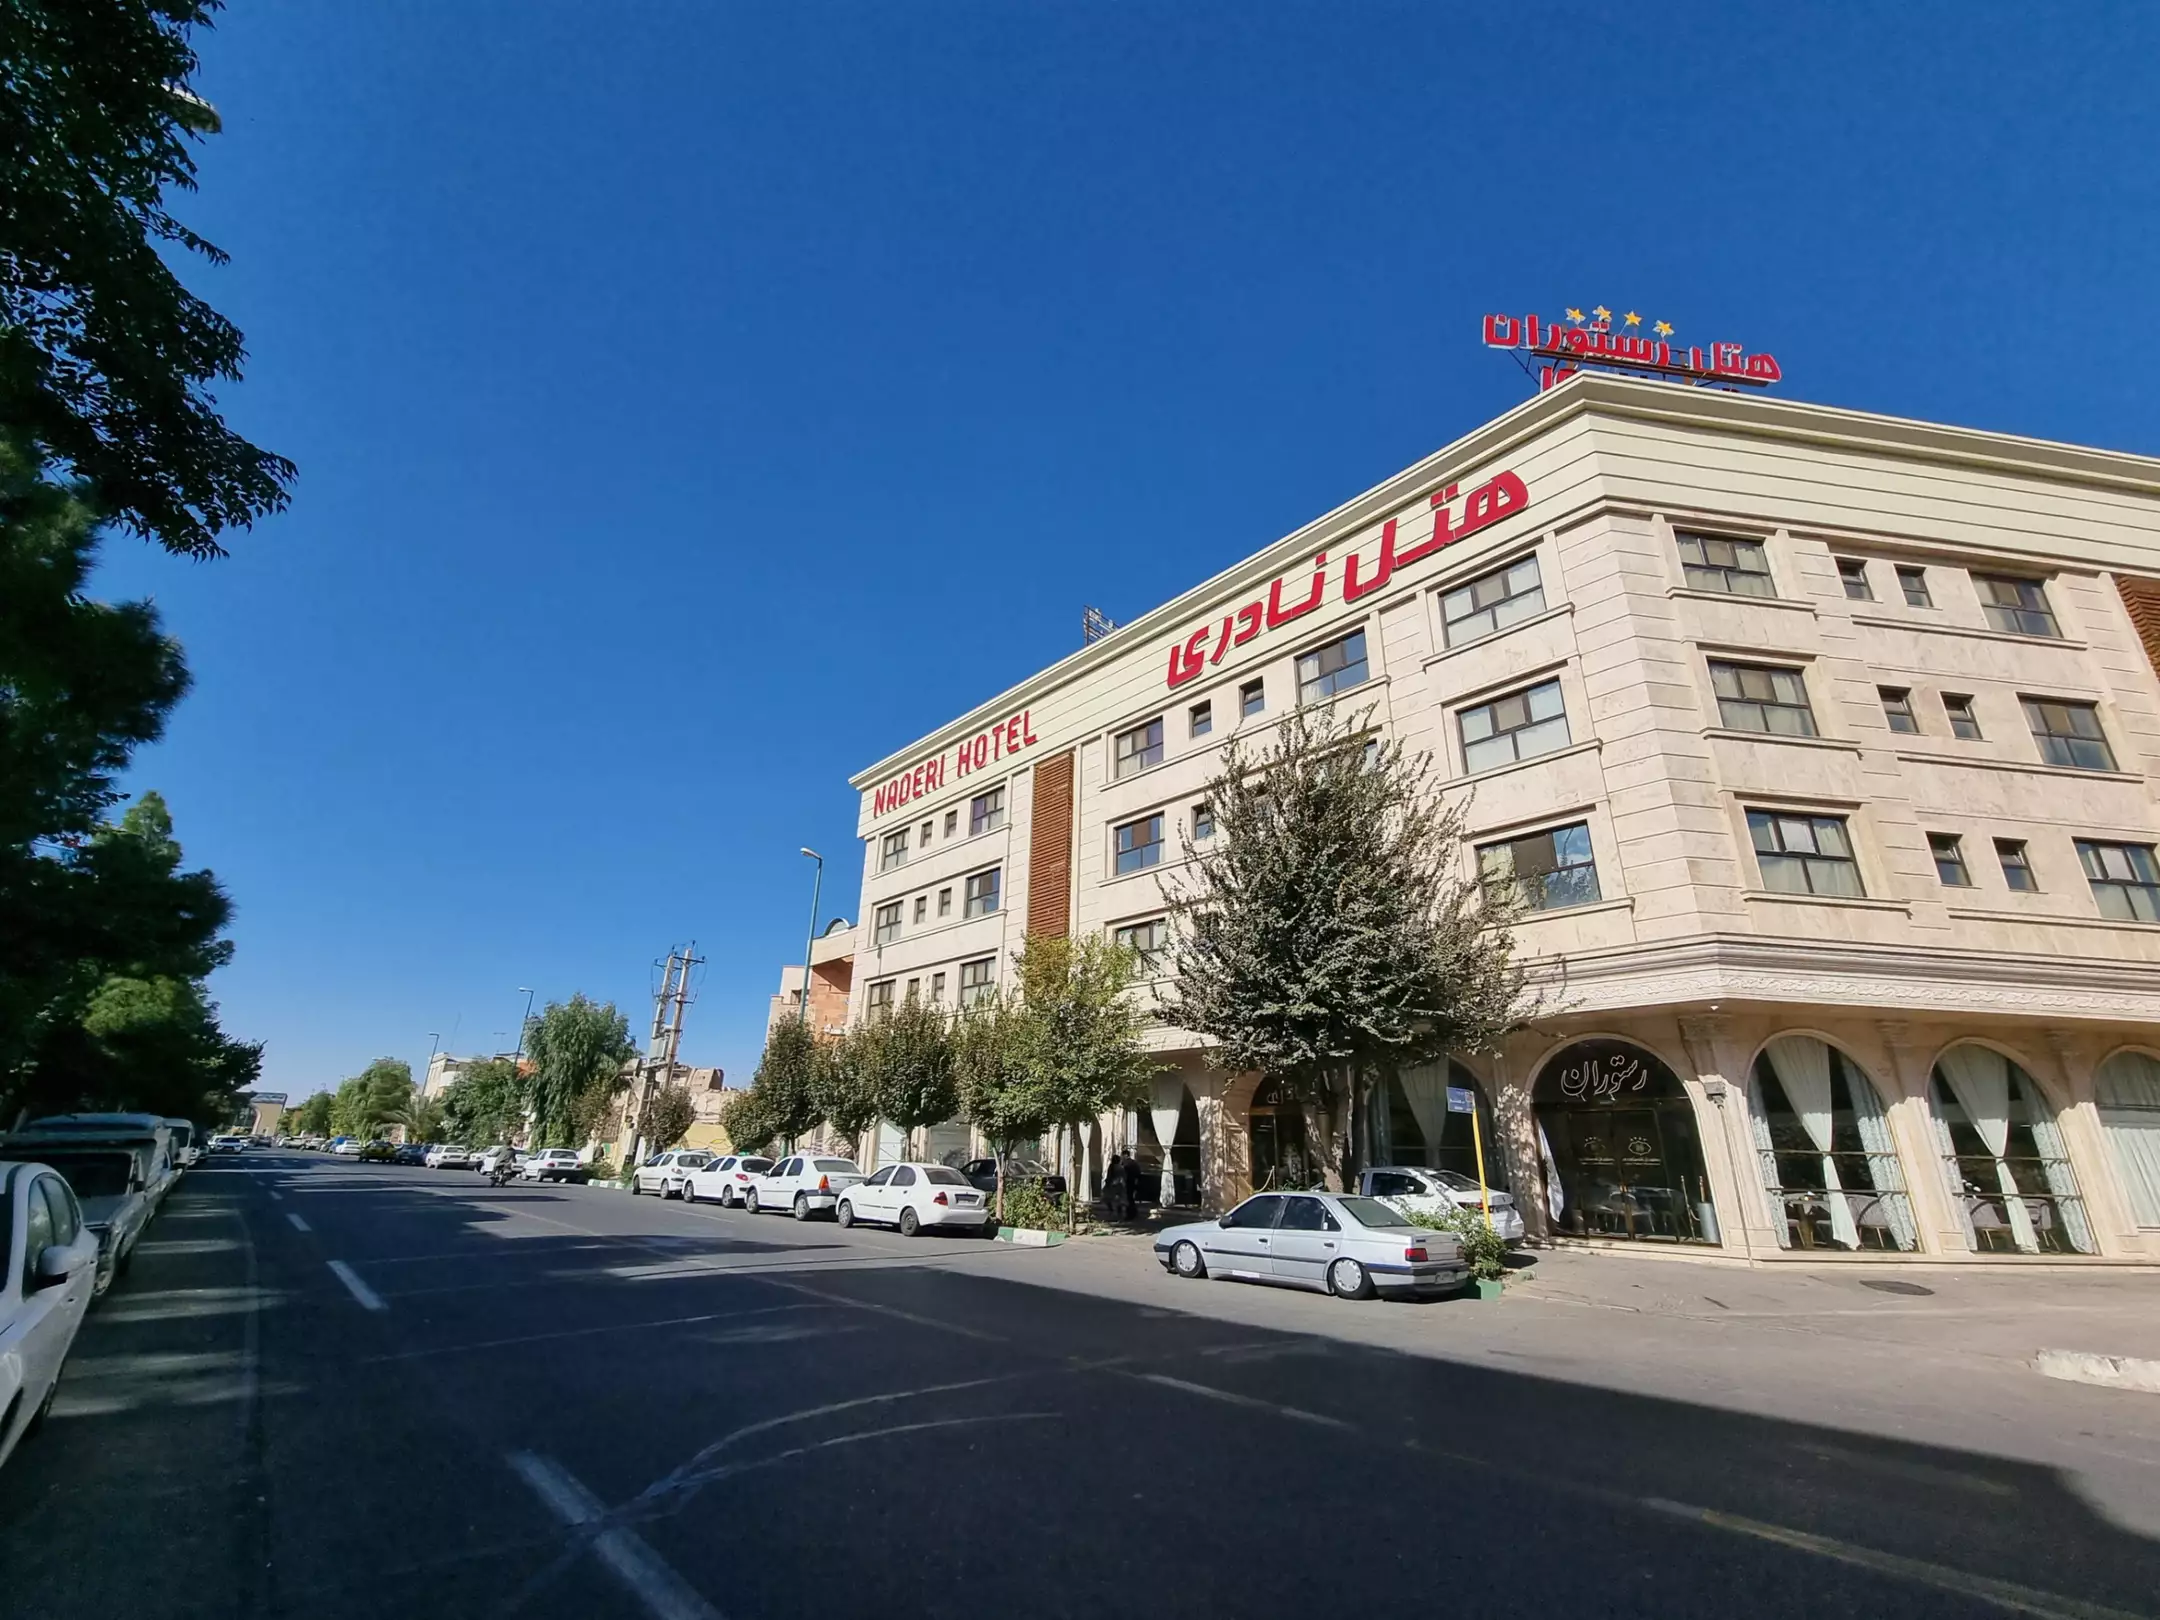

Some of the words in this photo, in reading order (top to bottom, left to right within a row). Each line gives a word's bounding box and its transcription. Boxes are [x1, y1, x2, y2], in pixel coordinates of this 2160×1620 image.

[1483, 314, 1670, 366] رستوران
[1690, 341, 1782, 383] هتل
[1343, 470, 1530, 604] هتل
[1167, 552, 1328, 689] نادری
[873, 753, 946, 819] NADERI
[957, 710, 1038, 778] HOTEL
[1561, 1055, 1647, 1097] رستوران
